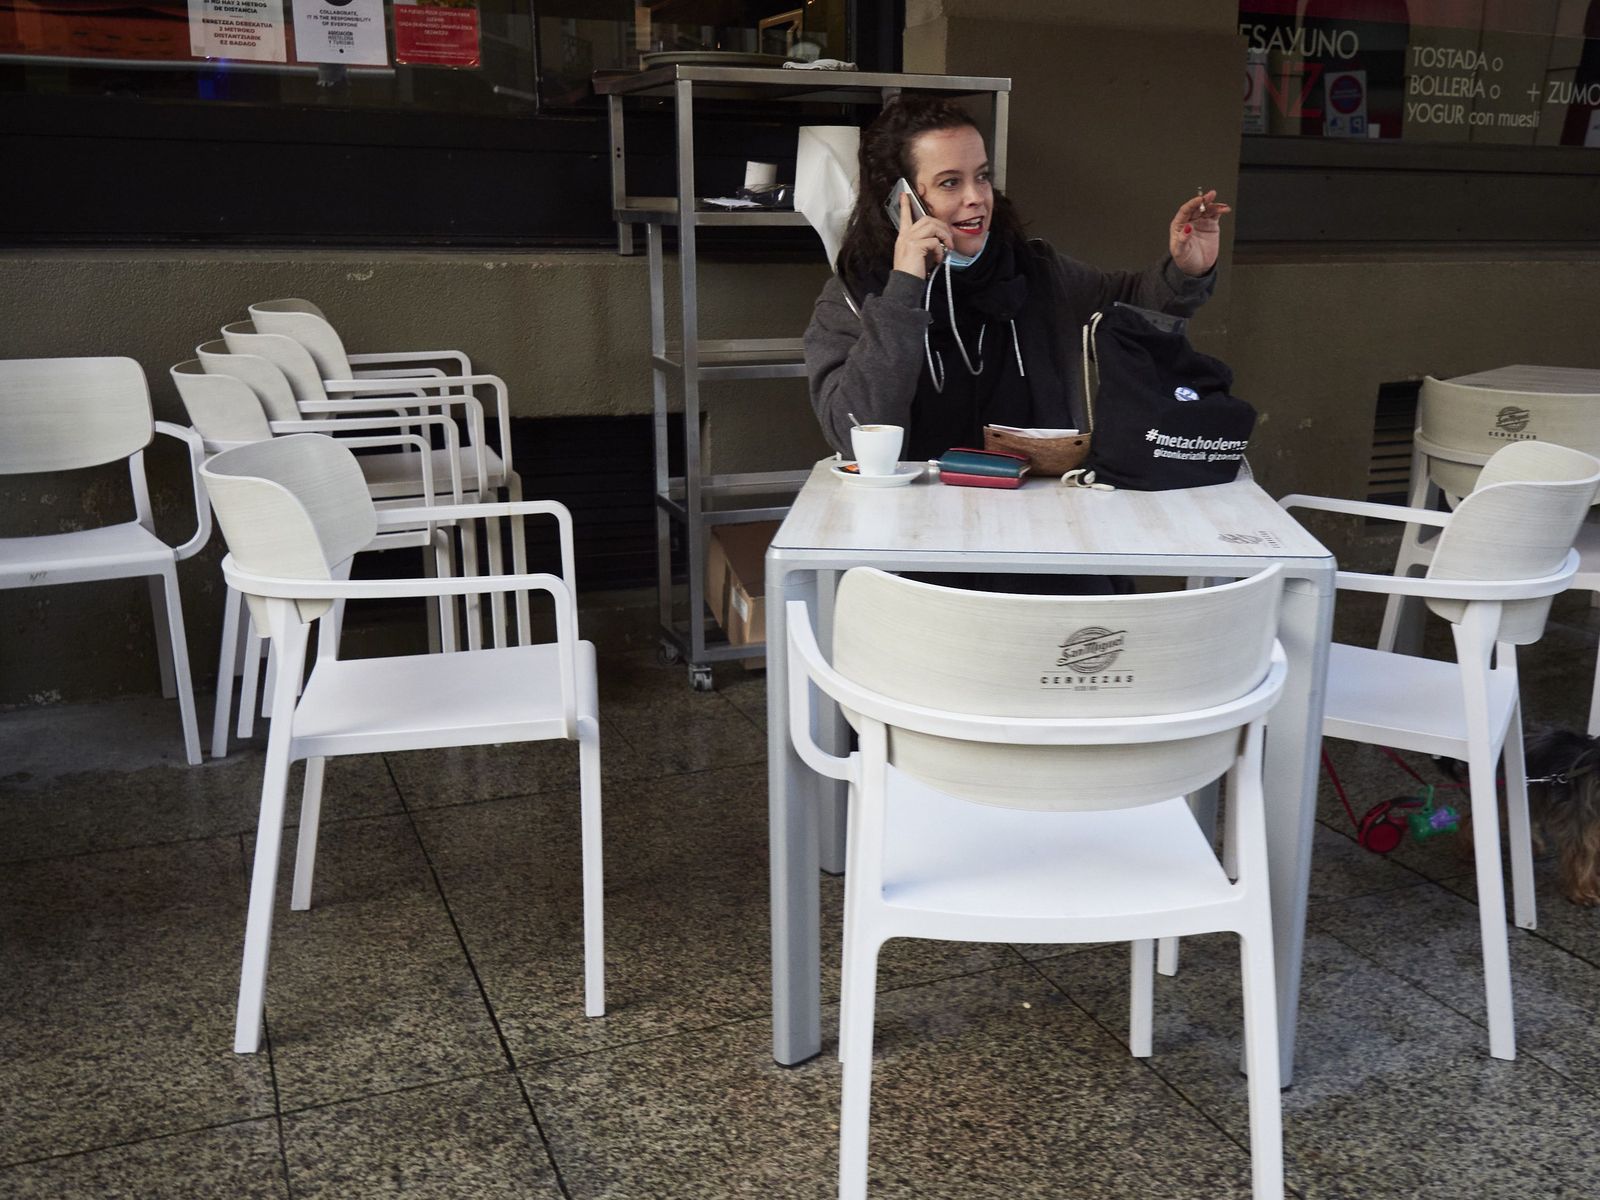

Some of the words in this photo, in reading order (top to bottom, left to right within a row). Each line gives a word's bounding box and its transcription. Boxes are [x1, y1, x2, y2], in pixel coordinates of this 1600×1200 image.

[224, 6, 258, 14] DISTANCIA
[235, 20, 273, 28] DEBEKATUA
[214, 32, 261, 41] DISTANTZIARIK
[1413, 46, 1488, 71] TOSTADA
[1492, 57, 1504, 72] o
[1409, 72, 1486, 98] BOLLERÍA
[1490, 85, 1500, 99] o
[1547, 81, 1600, 105] ZUMO
[1407, 102, 1464, 125] YOGUR
[1468, 111, 1494, 126] con
[1498, 110, 1540, 128] muesli
[1040, 675, 1134, 684] CERVEZAS
